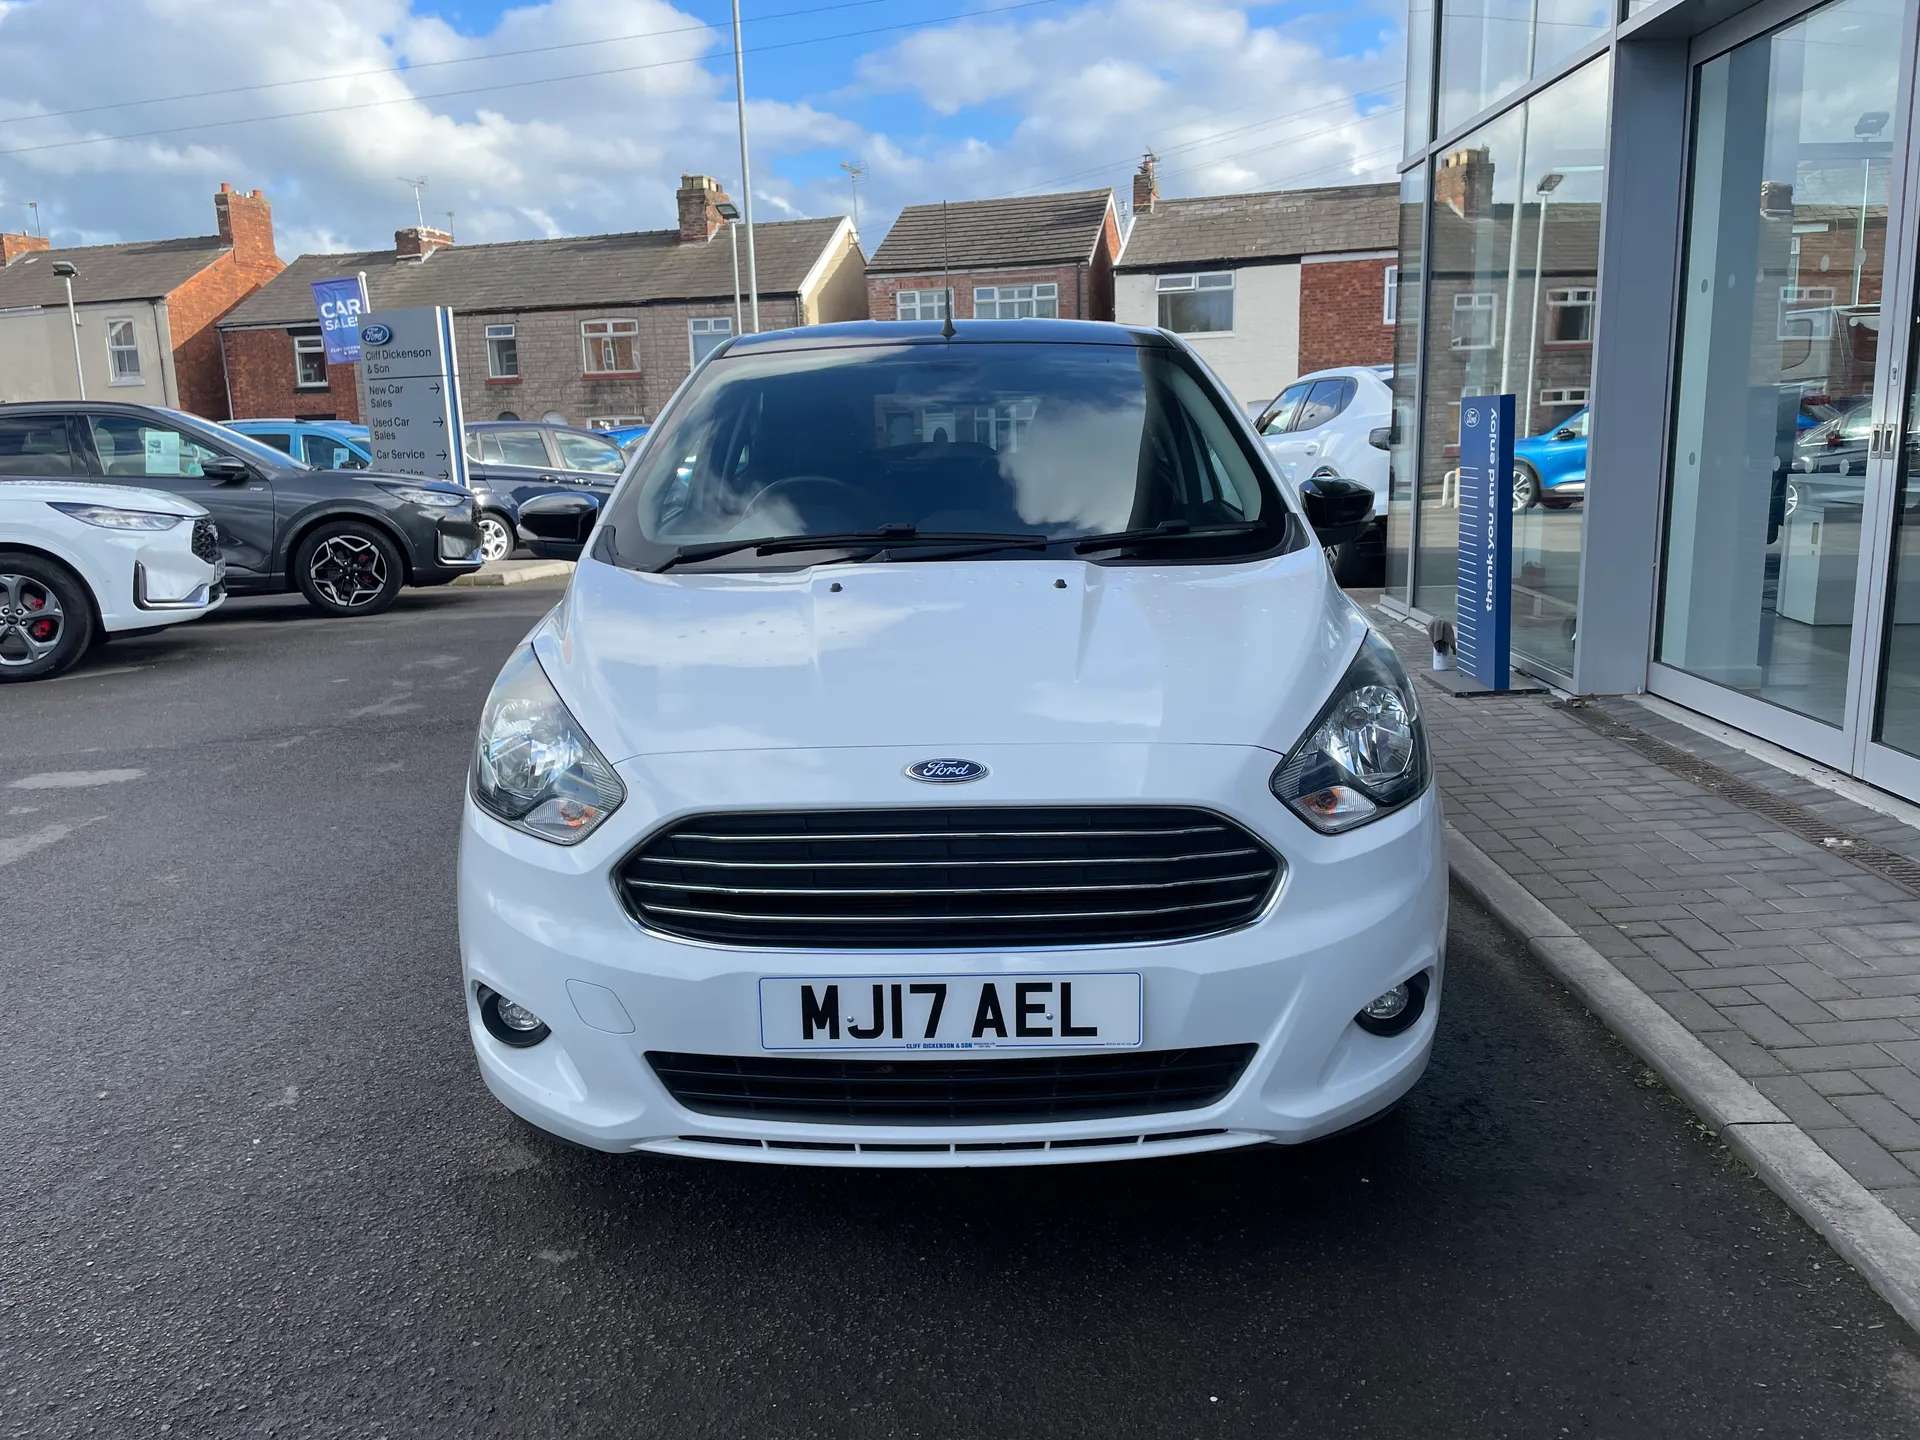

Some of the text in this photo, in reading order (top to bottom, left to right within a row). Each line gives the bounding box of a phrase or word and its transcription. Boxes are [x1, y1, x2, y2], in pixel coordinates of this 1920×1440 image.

[320, 298, 361, 319] CAR
[365, 327, 384, 341] Ford
[365, 349, 380, 361] Cliff
[382, 348, 432, 360] Dickenson
[367, 363, 390, 374] & Son
[369, 384, 403, 395] New Car
[370, 398, 393, 408] Sales
[372, 416, 410, 428] Used Car
[374, 430, 396, 440] Sales
[1489, 408, 1498, 465] enjoy
[376, 448, 425, 460] Car Service
[1486, 553, 1494, 612] thank
[923, 761, 970, 776] Ford
[801, 982, 1098, 1040] MJ17 AEL
